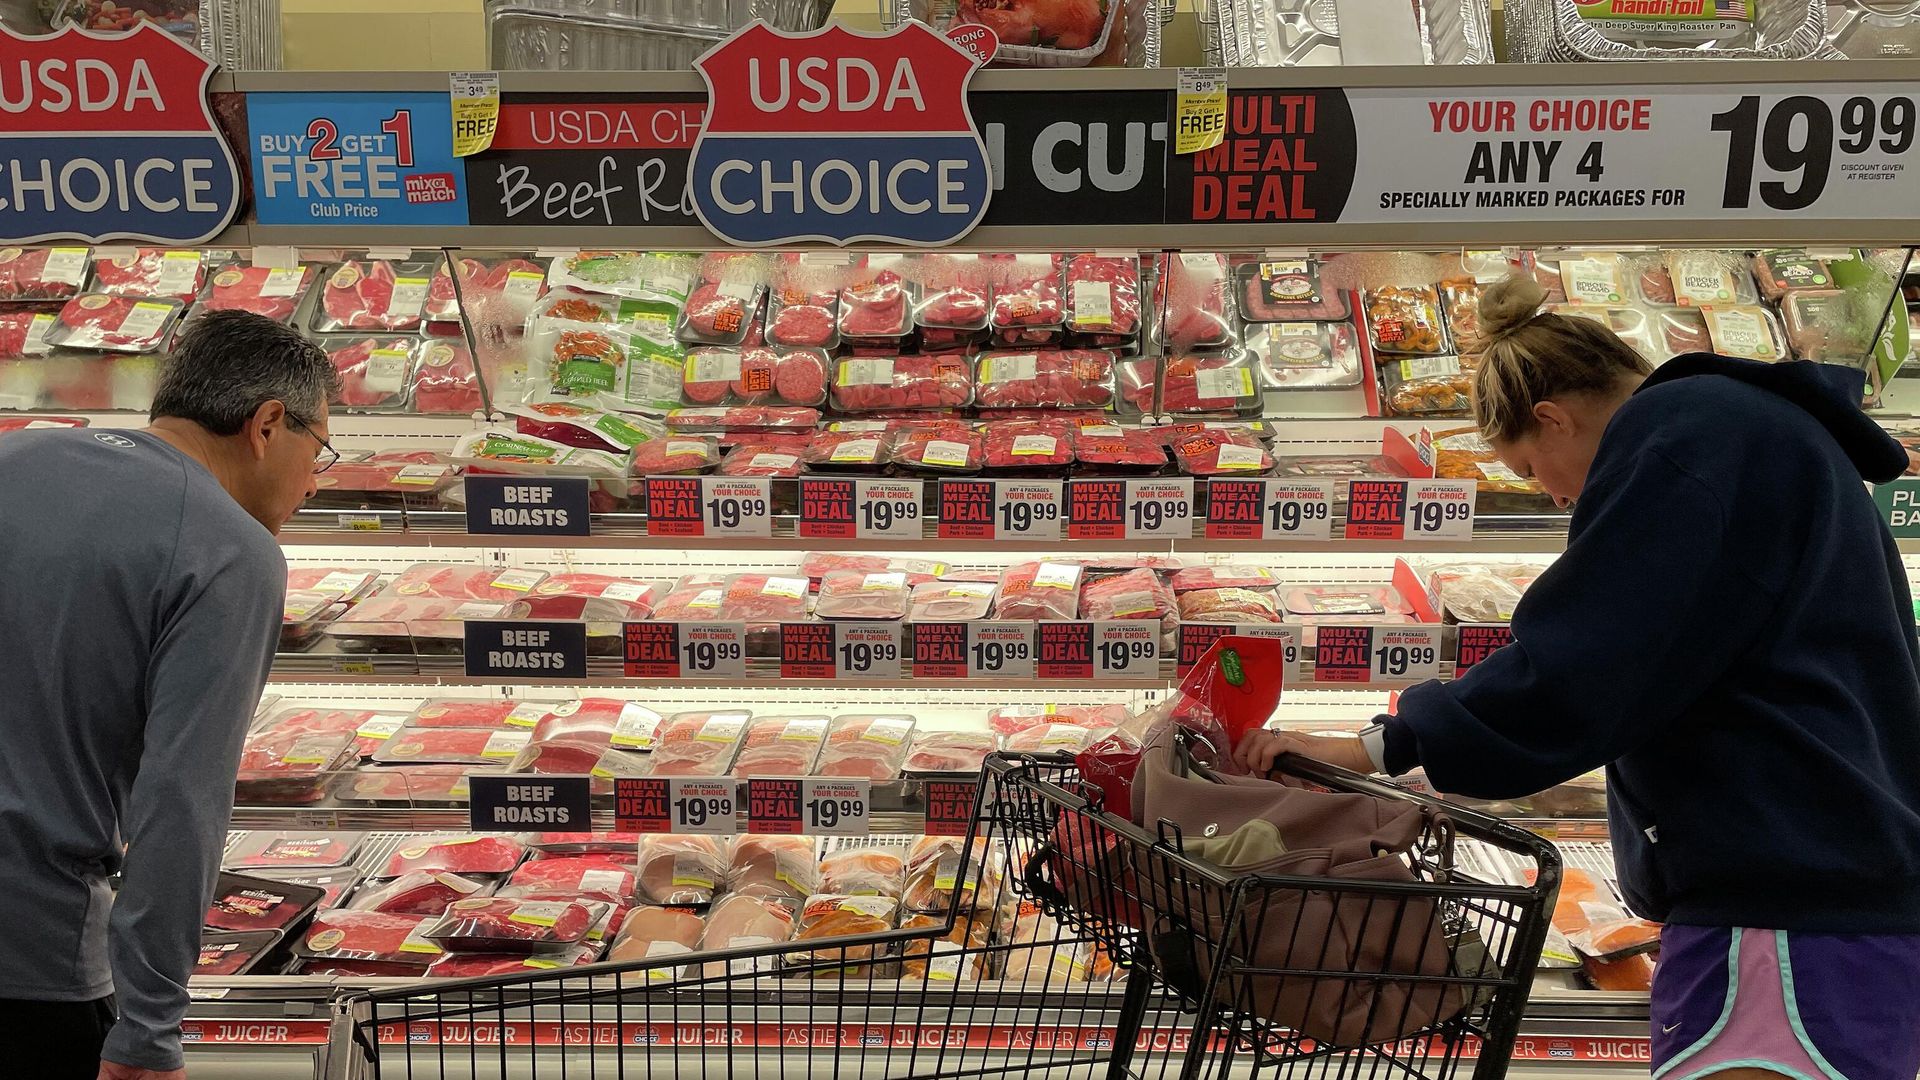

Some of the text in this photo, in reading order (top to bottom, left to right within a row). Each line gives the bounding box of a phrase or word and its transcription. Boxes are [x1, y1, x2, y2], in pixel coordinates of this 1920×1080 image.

[1588, 21, 1736, 31] tra Deep Super King Roaster Pan
[953, 29, 985, 45] RONG
[0, 59, 165, 113] USDA
[749, 57, 926, 112] USDA
[1180, 113, 1224, 134] FREE
[1428, 99, 1652, 132] YOUR CHOICE
[456, 118, 496, 138] FREE
[530, 111, 639, 144] USDA
[261, 109, 414, 167] BUY 2 GET 1
[1193, 139, 1318, 172] MEAL
[1464, 140, 1604, 184] ANY 4
[262, 156, 400, 198] FREE
[406, 177, 430, 191] mix
[0, 158, 218, 213] HOICE
[497, 156, 623, 225] Beef
[711, 159, 970, 214] CHOICE
[407, 188, 456, 202] match
[1192, 174, 1316, 220] DEAL
[1380, 189, 1685, 209] SPECIALLY MARKED PACKAGES FOR
[311, 203, 378, 217] Club Price
[649, 480, 696, 490] MULTI
[804, 481, 850, 491] MULTI
[943, 483, 989, 493] MULTI
[1073, 483, 1120, 493] MULTI
[1212, 483, 1260, 493] MULTI
[1353, 483, 1402, 493] MULTI
[504, 486, 552, 503] BEEF
[804, 492, 852, 500] MEAL
[1072, 493, 1121, 501] MEAL
[1353, 493, 1402, 501] MEAL
[1440, 492, 1467, 500] CHOICE
[1893, 491, 1920, 506] PL
[491, 508, 568, 526] ROASTS
[650, 500, 699, 518] DEAL
[804, 501, 852, 519] DEAL
[943, 503, 991, 520] DEAL
[1073, 503, 1121, 520] DEAL
[1211, 502, 1259, 520] DEAL
[1352, 503, 1400, 520] DEAL
[1890, 510, 1920, 526] BA
[626, 624, 672, 634] MULTI
[784, 625, 829, 634] MULTI
[916, 625, 962, 634] MULTI
[1042, 625, 1088, 634] MULTI
[1184, 626, 1230, 635] MULTI
[1320, 628, 1367, 637] MULTI
[502, 630, 550, 647] BEEF
[1320, 638, 1368, 646] MEAL
[627, 643, 675, 660] DEAL
[785, 643, 832, 661] DEAL
[916, 643, 964, 661] DEAL
[1042, 643, 1089, 660] DEAL
[1319, 648, 1367, 664] DEAL
[488, 651, 565, 669] ROASTS
[618, 781, 664, 789] MULTI
[751, 782, 797, 790] MULTI
[507, 786, 554, 801] BEEF
[494, 807, 569, 823] ROASTS
[619, 799, 667, 816] DEAL
[751, 800, 799, 817] DEAL
[215, 1026, 288, 1042] JUICIER
[443, 1026, 515, 1042] JUICIER
[671, 1028, 743, 1044] JUICIER
[777, 1028, 847, 1044] TASTIER
[896, 1030, 967, 1045] JUICIER
[1003, 1030, 1074, 1047] TASTIER
[1587, 1042, 1651, 1059] JUICIE
